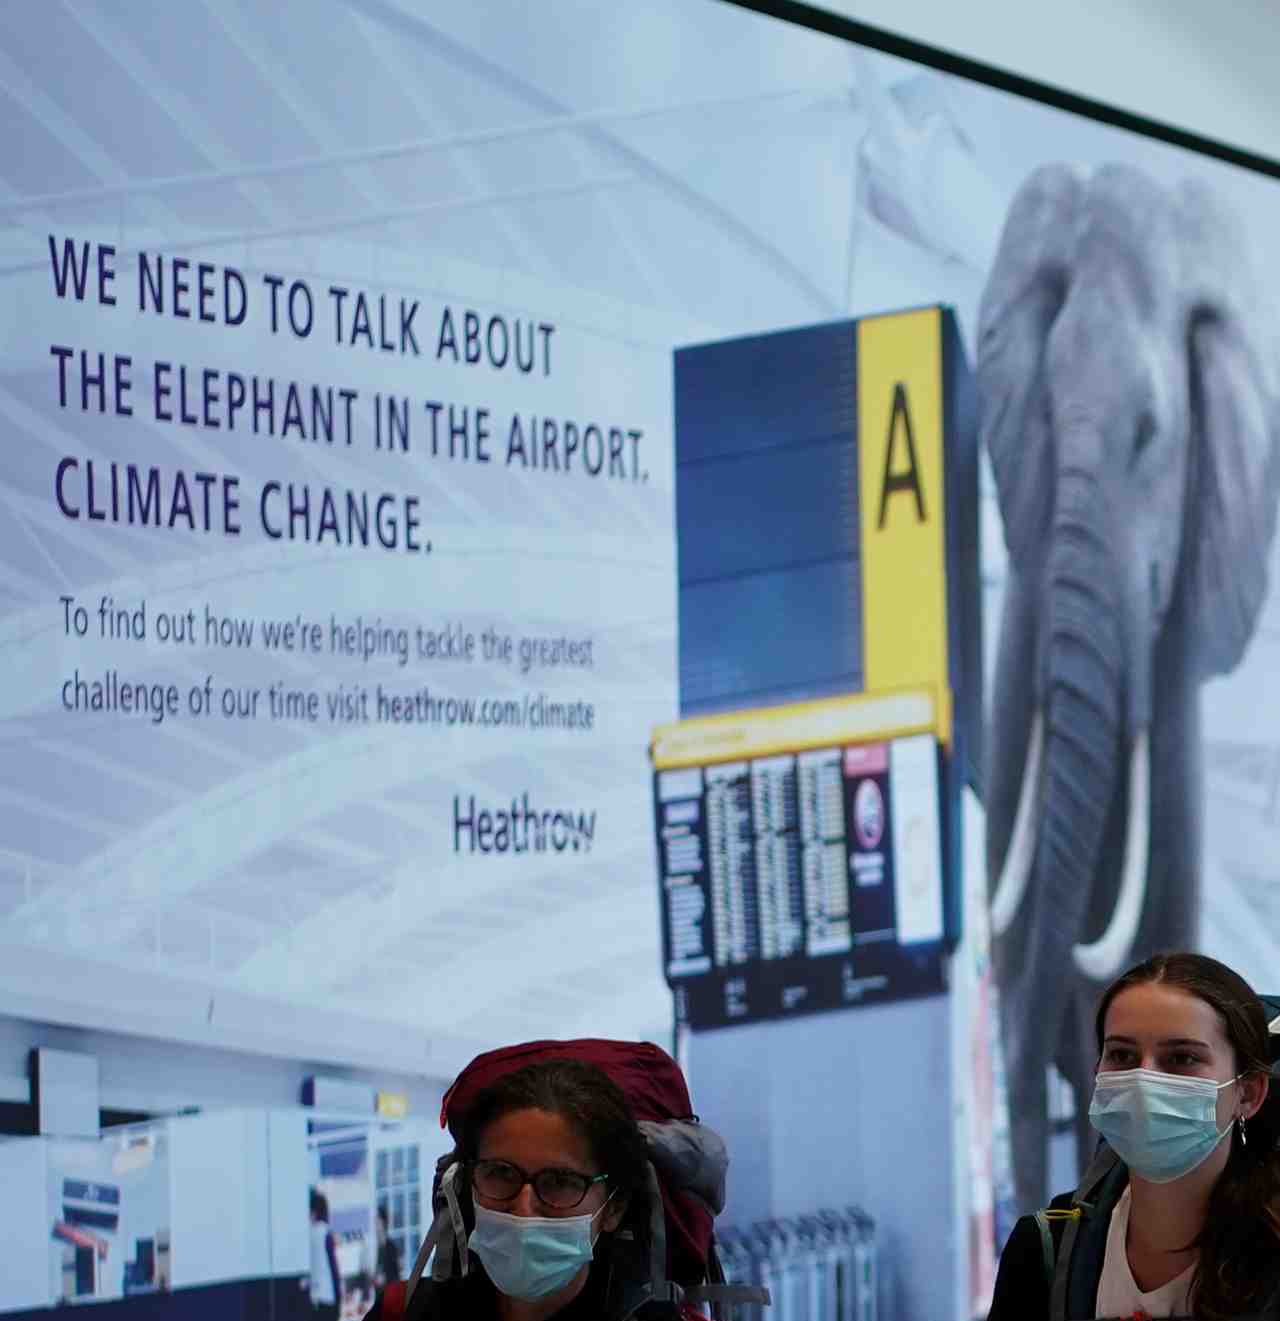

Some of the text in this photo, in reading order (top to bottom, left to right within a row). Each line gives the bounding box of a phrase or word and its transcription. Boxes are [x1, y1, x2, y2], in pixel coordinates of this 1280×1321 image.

[49, 234, 555, 376] WE NEED TO TALK ABOUT
[50, 345, 648, 480] THE ELEPHANT IN THE AIRPORT.
[877, 380, 927, 532] A
[56, 457, 432, 552] CLIMATE CHANGE.
[59, 596, 88, 636] To
[97, 596, 146, 640] find
[156, 609, 195, 645] out
[205, 603, 254, 648] how
[261, 615, 323, 653] we're
[329, 615, 409, 668] helping
[416, 623, 475, 661] tackle
[480, 628, 512, 664] the
[62, 669, 594, 730] challenge of our time visit heathrow.com/climate
[454, 793, 596, 854] Heathrow
